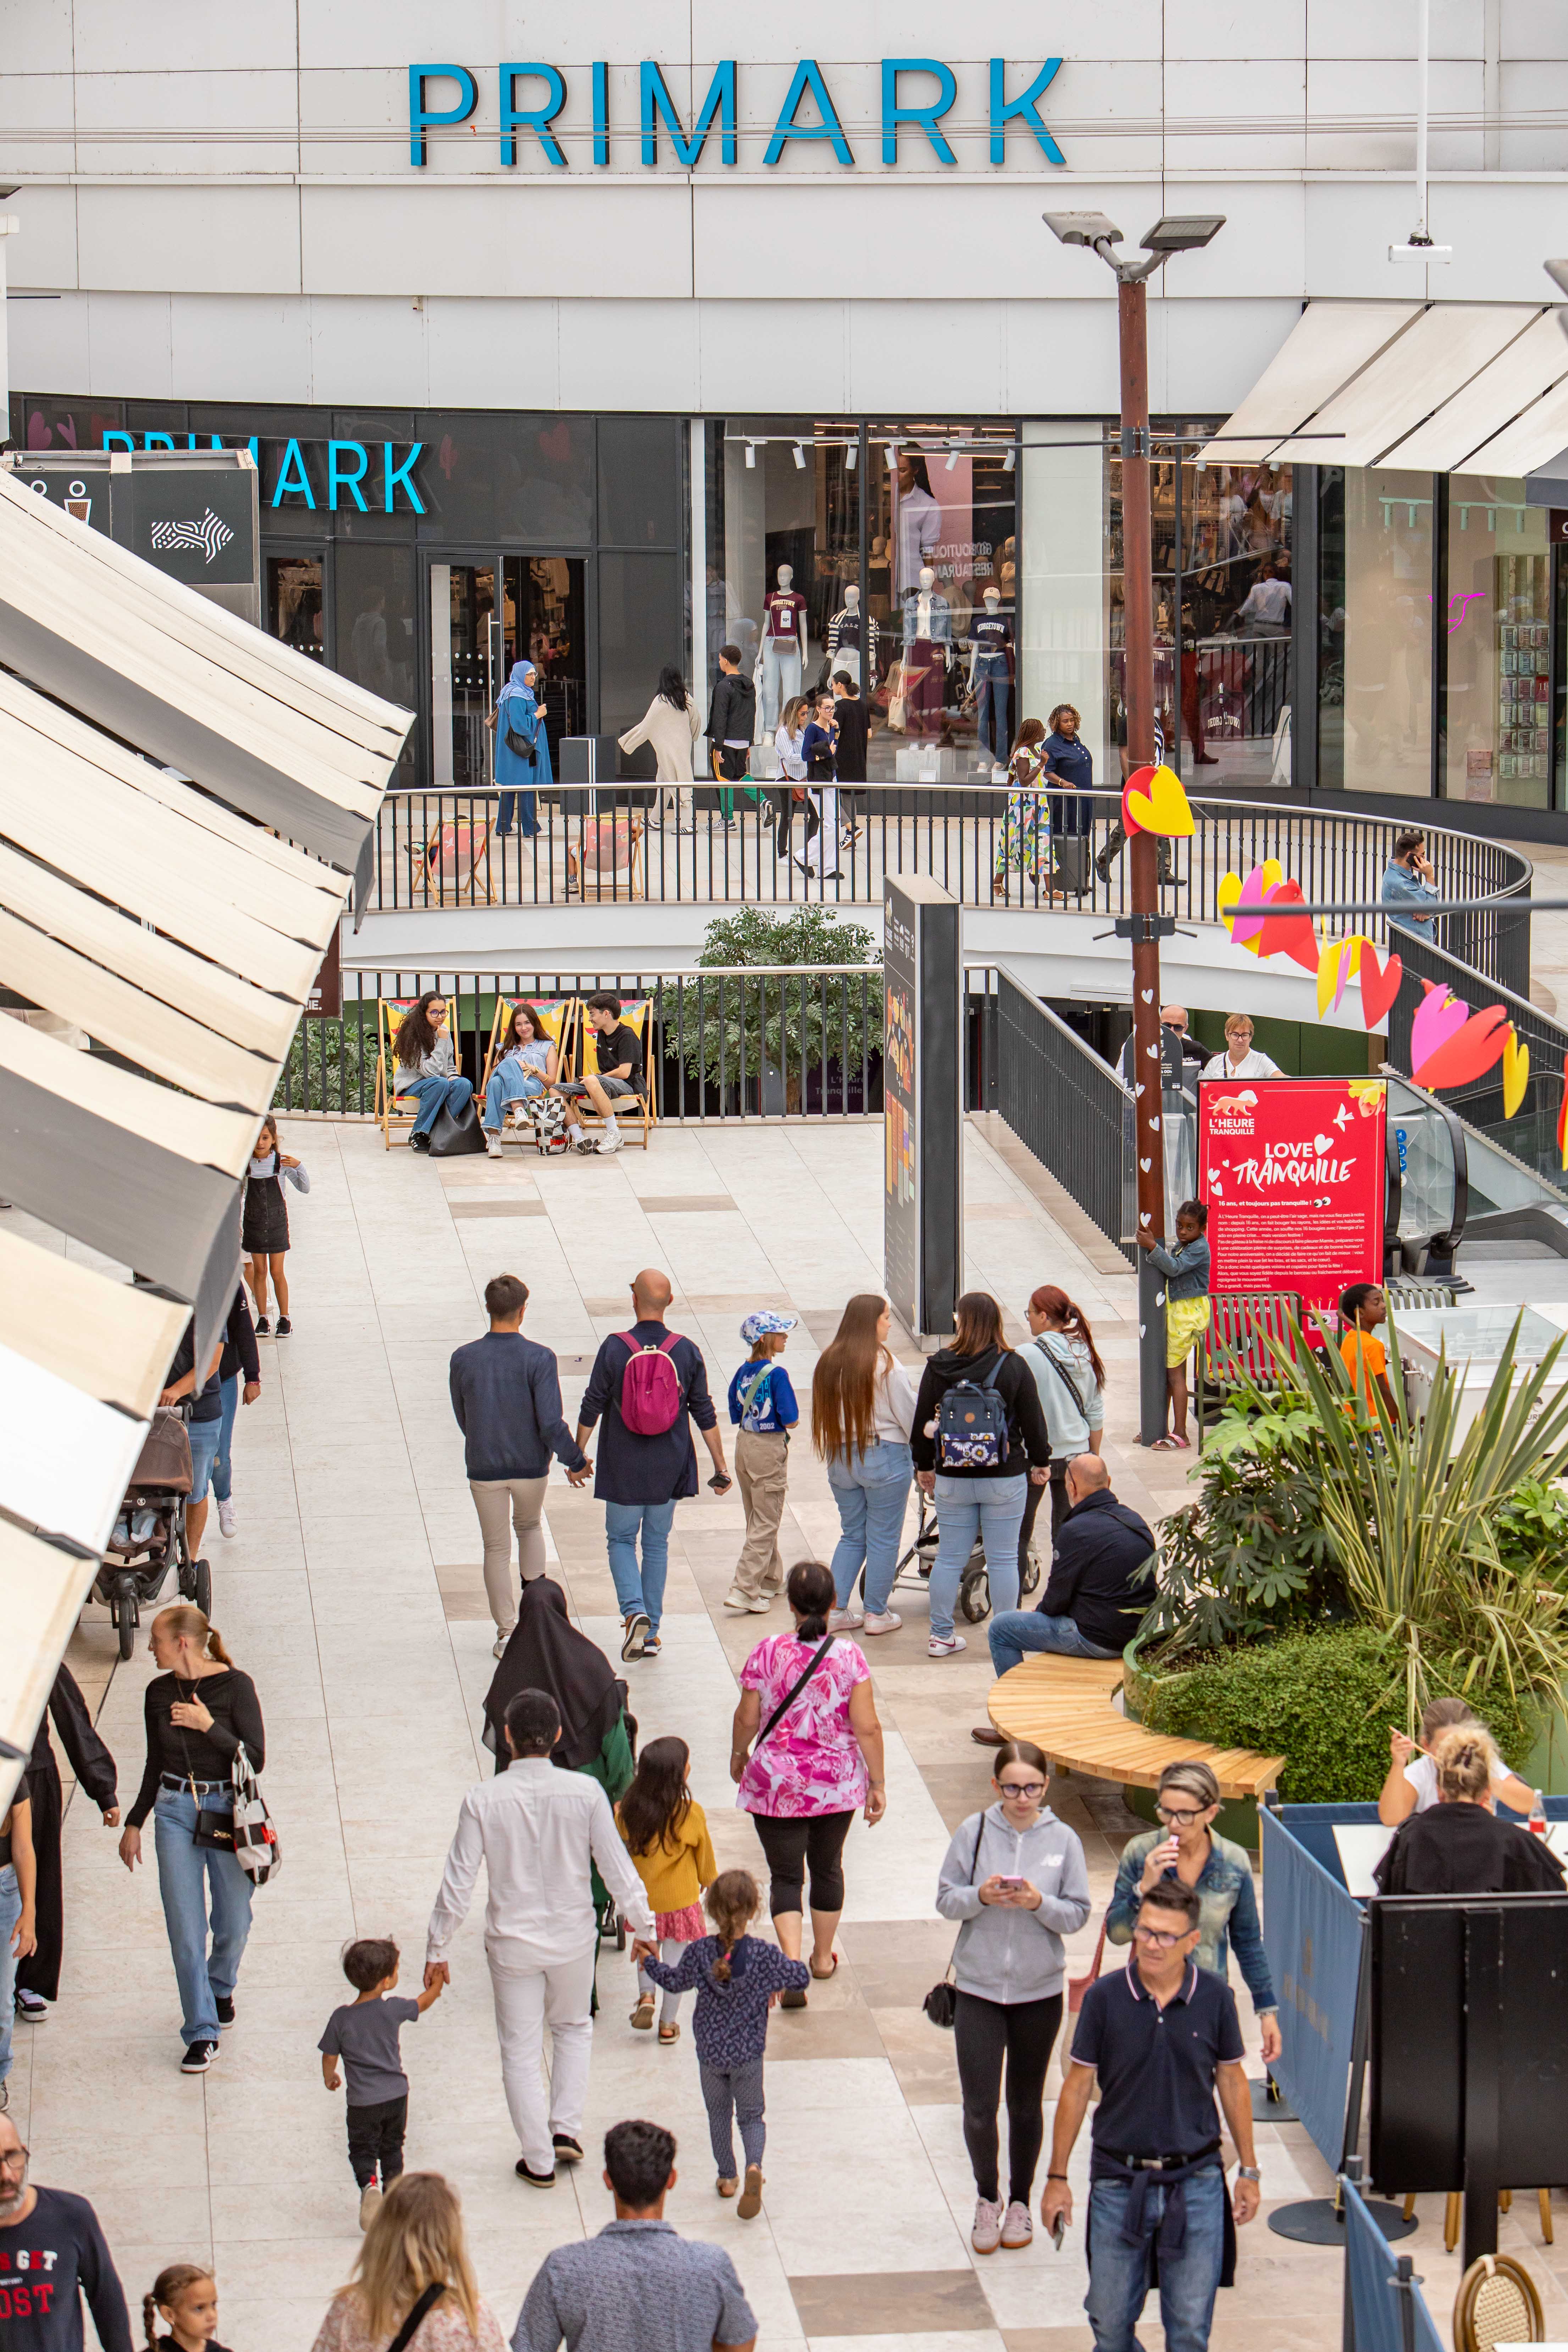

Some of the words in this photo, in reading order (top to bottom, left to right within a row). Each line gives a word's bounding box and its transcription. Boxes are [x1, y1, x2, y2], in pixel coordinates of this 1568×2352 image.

[409, 57, 1066, 166] PRIMARK
[977, 622, 1005, 633] GEORGETOWN
[1209, 1118, 1255, 1128] L'HEURE
[1265, 1143, 1313, 1158] LOVE
[1232, 1158, 1357, 1192] TRANQUILLE
[759, 1422, 775, 1430] 2002
[0, 2284, 53, 2319] OST
